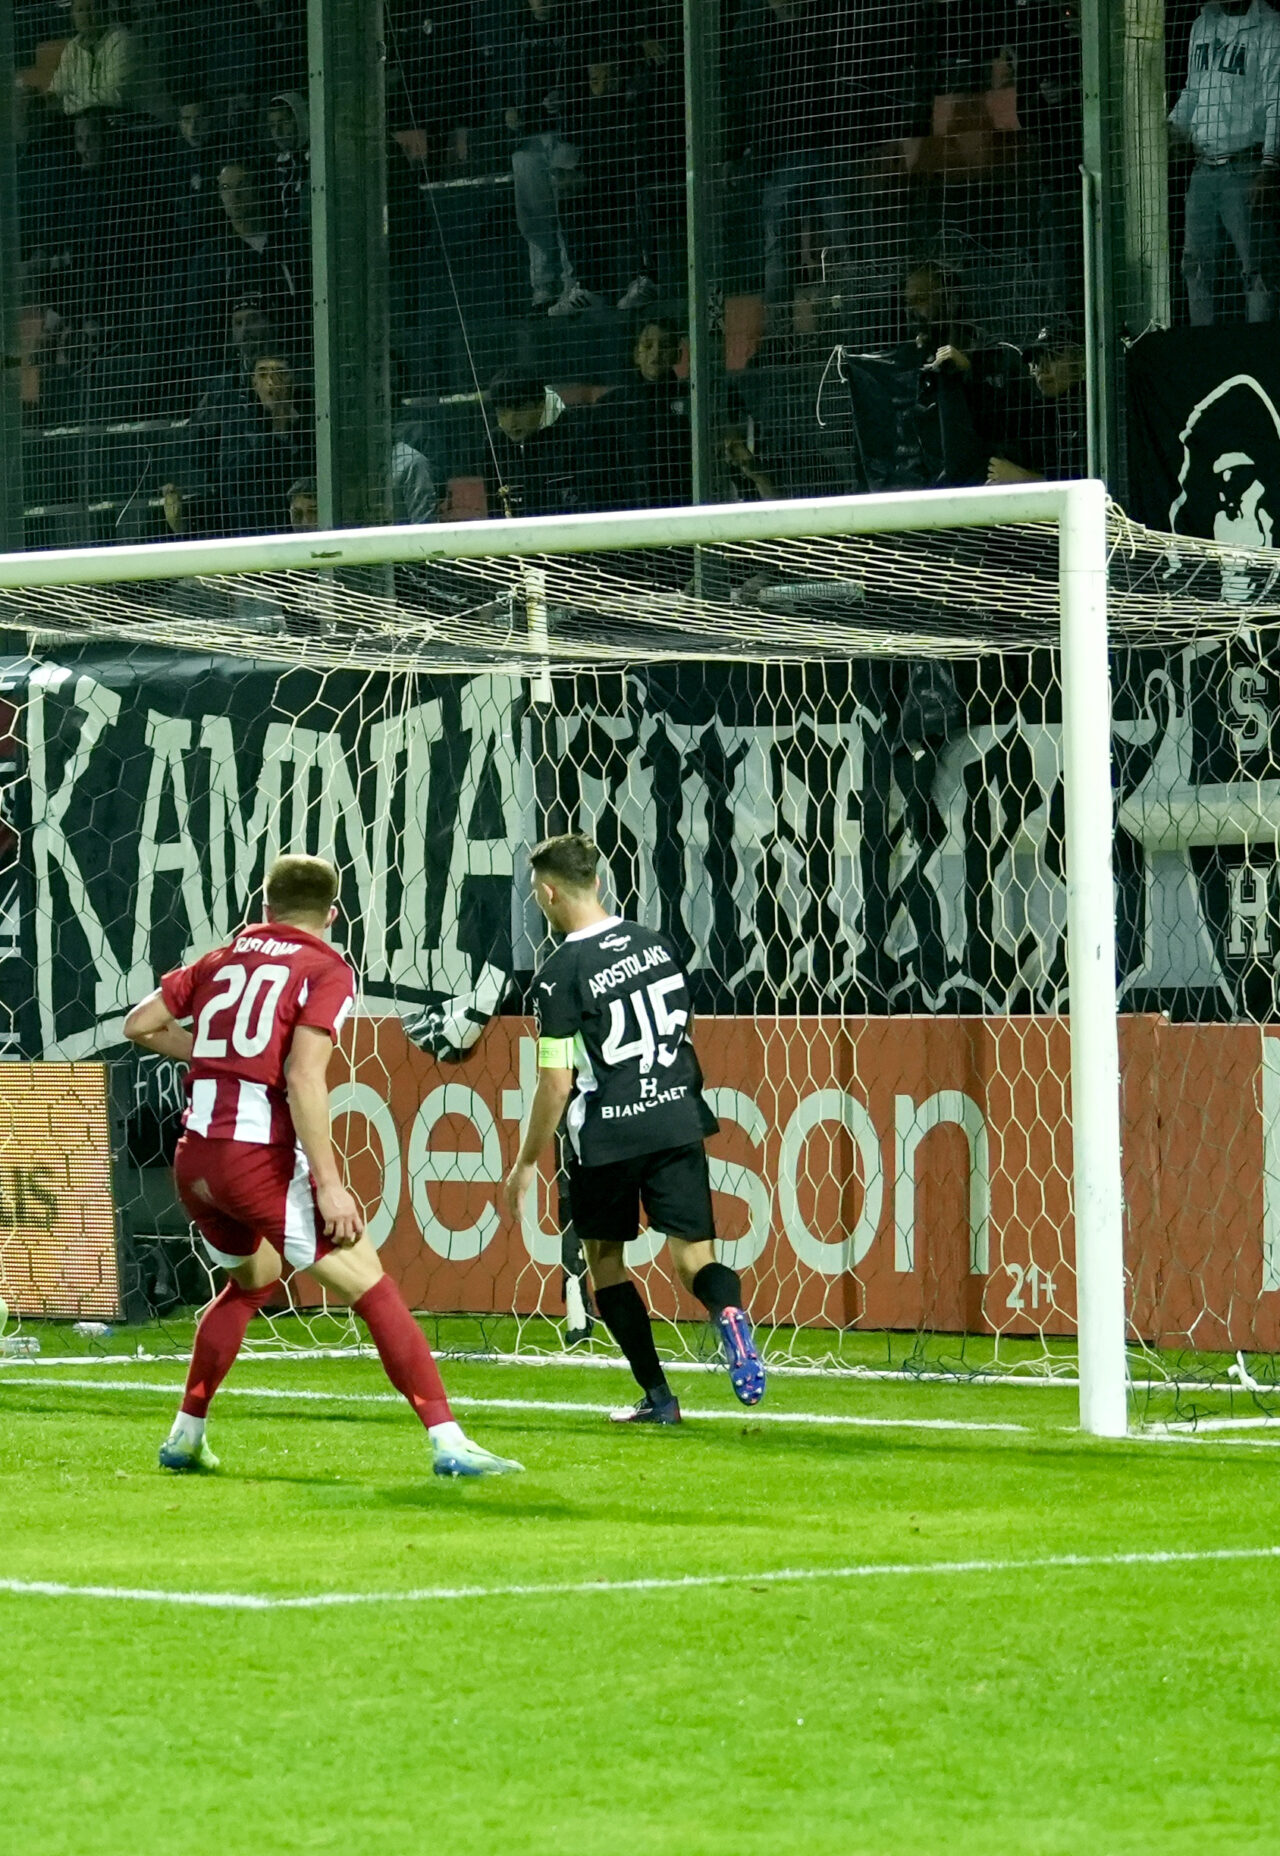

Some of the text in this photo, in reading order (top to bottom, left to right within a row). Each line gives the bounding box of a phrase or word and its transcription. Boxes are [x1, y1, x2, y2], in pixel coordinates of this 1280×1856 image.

[192, 963, 290, 1058] 20
[601, 972, 688, 1074] 45
[601, 1085, 688, 1119] BIANCHET
[1006, 1262, 1057, 1309] 21+
